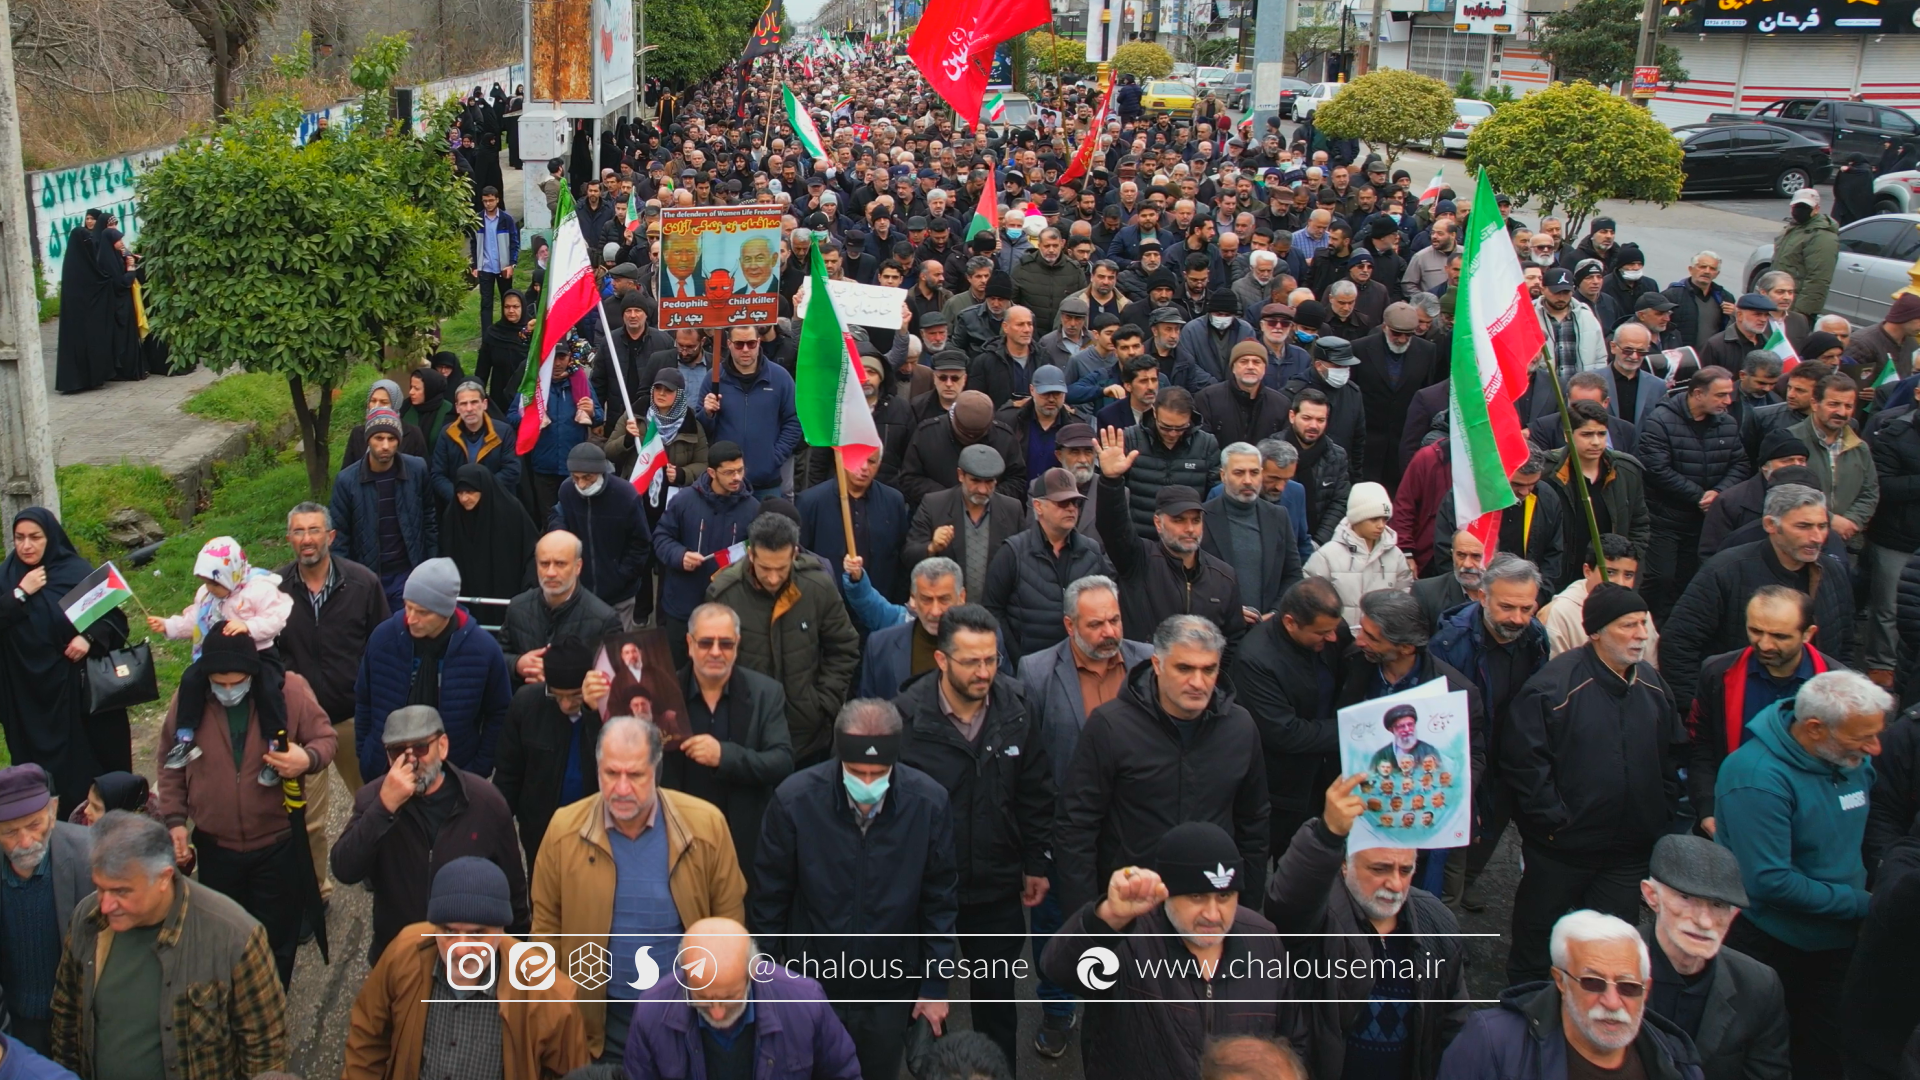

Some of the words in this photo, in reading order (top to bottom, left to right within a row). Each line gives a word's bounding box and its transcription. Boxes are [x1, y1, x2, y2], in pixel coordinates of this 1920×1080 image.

[1758, 8, 1820, 32] فرحان
[676, 210, 708, 218] defenders
[663, 220, 692, 236] آزادی
[692, 220, 722, 235] زندگی
[725, 221, 737, 233] زن
[740, 216, 781, 232] مدافعان
[662, 300, 709, 309] Pedophile
[667, 312, 682, 326] باز
[684, 313, 703, 326] بچه
[749, 311, 768, 321] بچه
